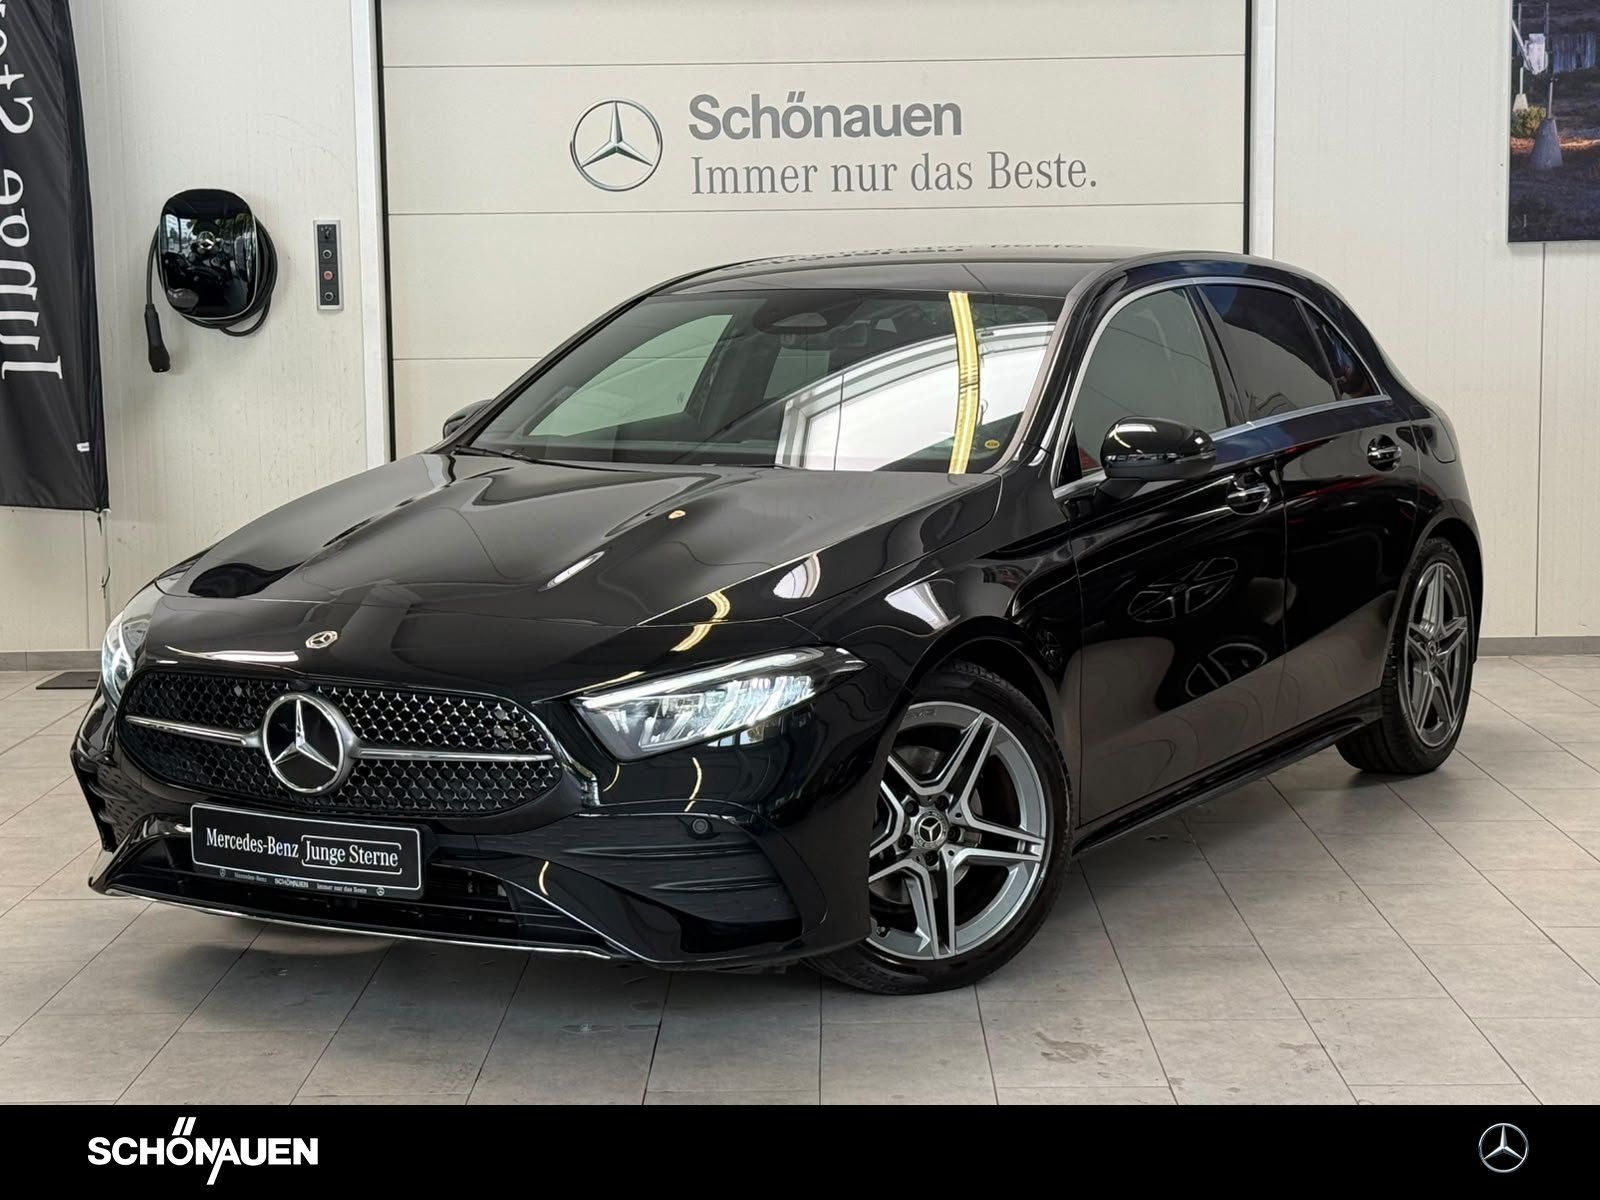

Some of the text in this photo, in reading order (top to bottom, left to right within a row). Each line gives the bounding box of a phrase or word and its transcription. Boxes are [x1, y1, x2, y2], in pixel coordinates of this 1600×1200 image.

[688, 91, 962, 141] Schönauen
[691, 151, 1097, 195] Immer nur das Beste.
[206, 827, 399, 867] Mercedes-Benz Junge Sterne
